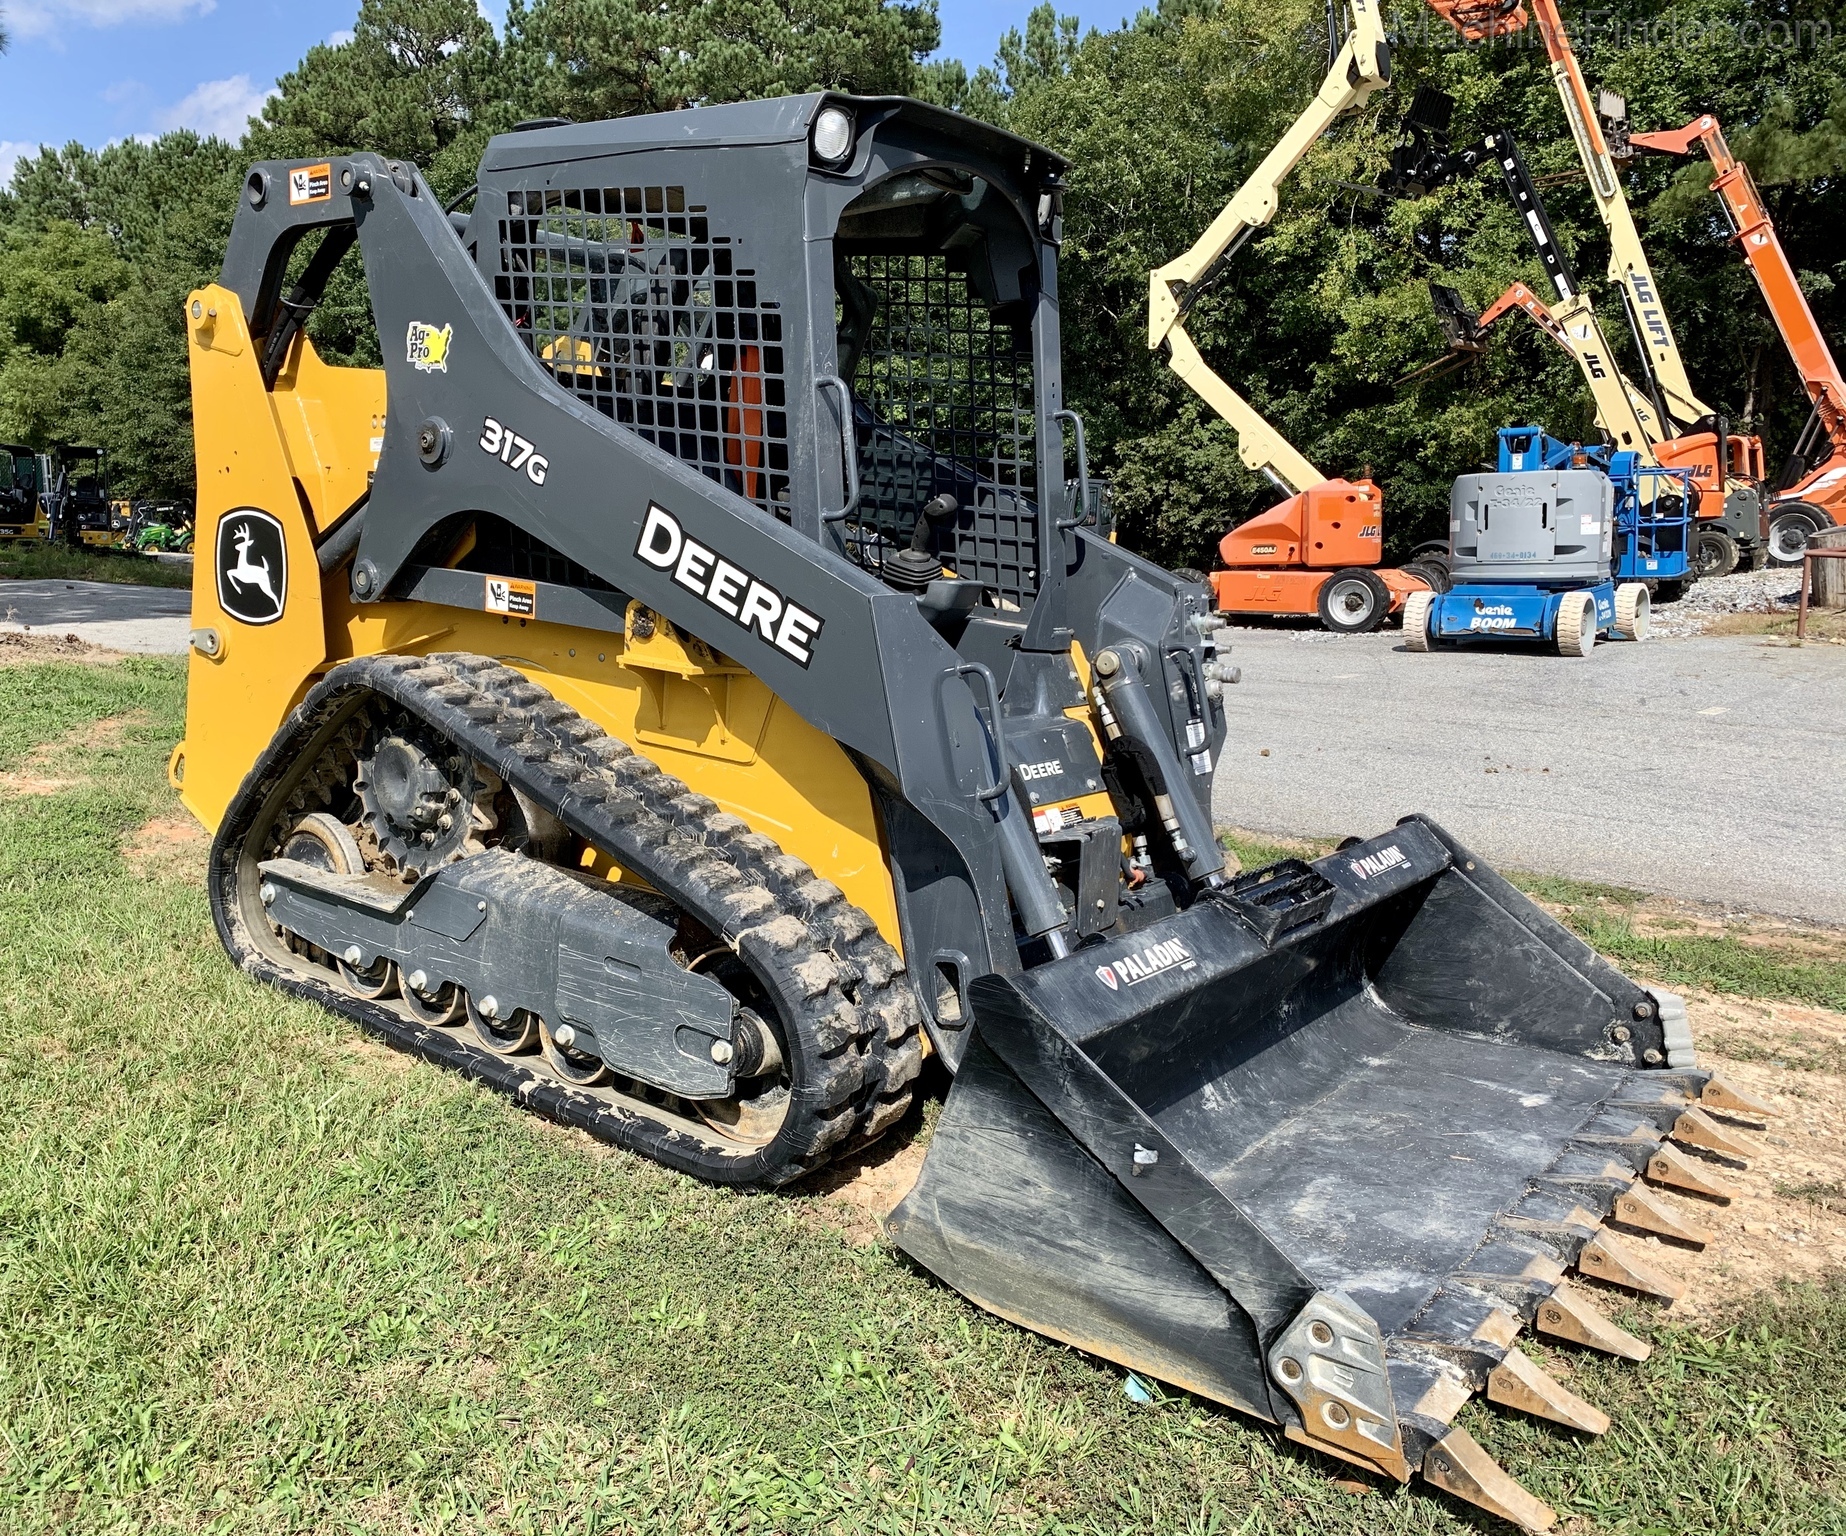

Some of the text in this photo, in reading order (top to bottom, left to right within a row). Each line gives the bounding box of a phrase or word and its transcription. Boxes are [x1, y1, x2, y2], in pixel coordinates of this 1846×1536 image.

[1630, 273, 1671, 347] JLG LIFT
[410, 325, 430, 345] Ag-
[409, 342, 430, 359] Pro
[1582, 352, 1607, 379] JLG
[479, 416, 549, 486] 317G
[1689, 464, 1713, 477] JLG
[1494, 484, 1535, 498] Genie
[1358, 525, 1376, 538] JLG
[635, 502, 823, 667] DEERE
[1244, 586, 1282, 601] JLG
[1470, 617, 1517, 629] BOOM
[1019, 760, 1063, 781] DEERE
[1359, 844, 1406, 875] PALADIN
[1112, 938, 1190, 983] PALADIN
